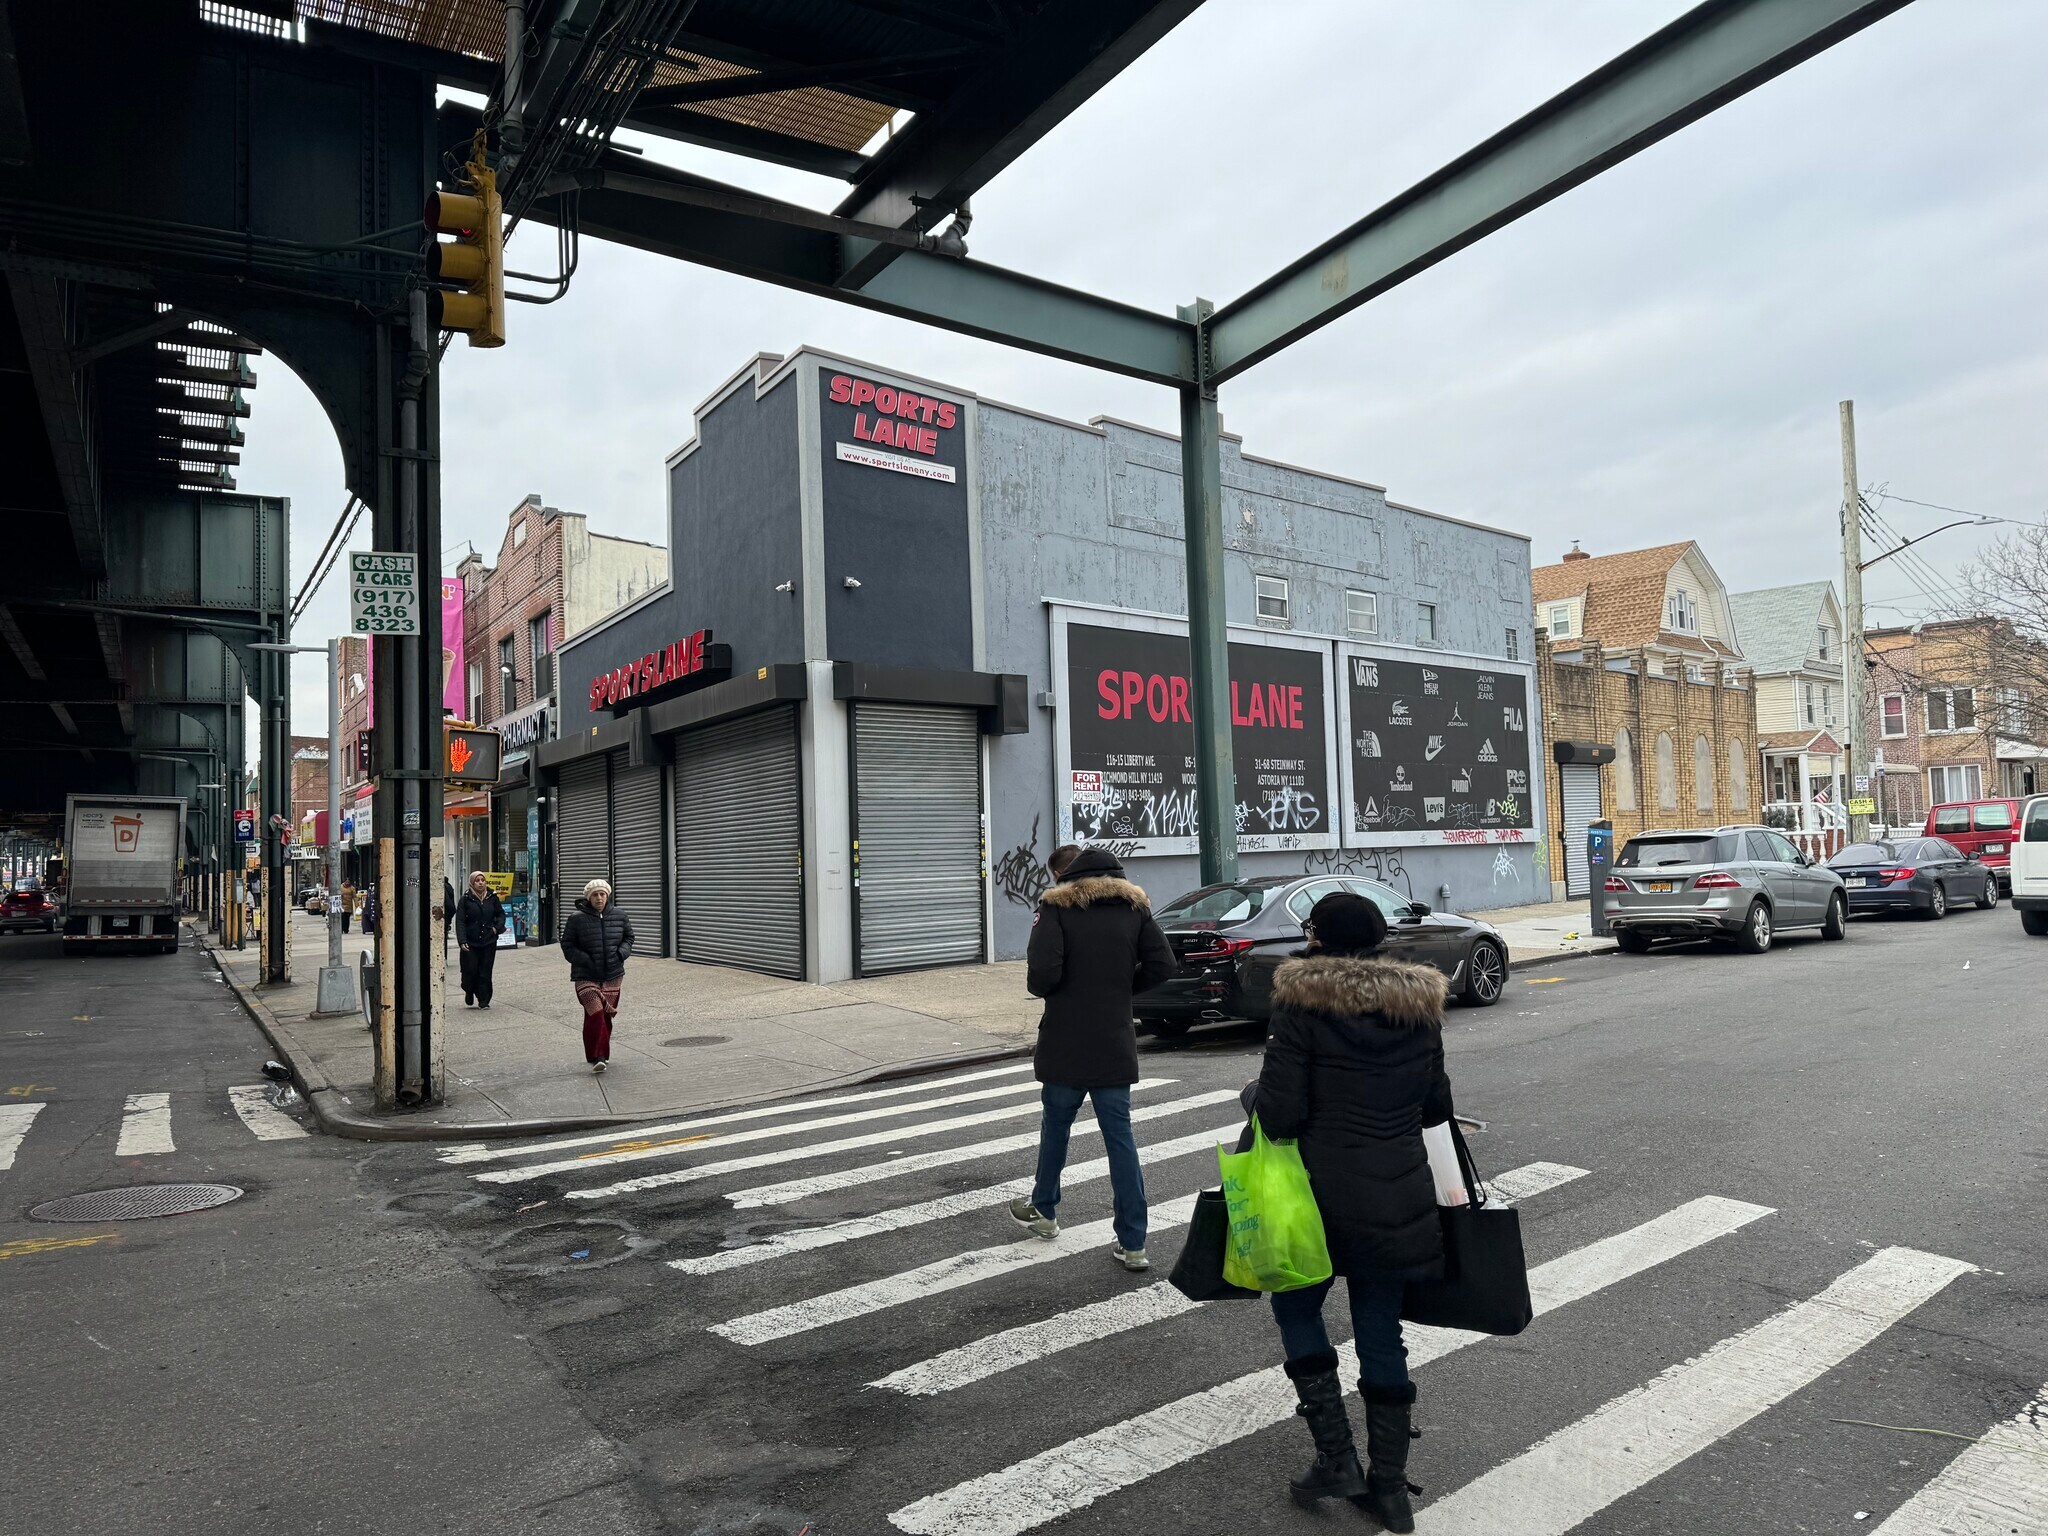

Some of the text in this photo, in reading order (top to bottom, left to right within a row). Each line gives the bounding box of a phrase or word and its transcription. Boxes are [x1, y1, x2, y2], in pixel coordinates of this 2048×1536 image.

[829, 375, 956, 429] SPORTS
[853, 412, 938, 455] LANE
[843, 452, 950, 480] www.sportslaneny.com
[356, 572, 412, 586] 4 CARS
[353, 588, 415, 605] (917)
[362, 605, 408, 618] 436
[355, 618, 415, 632] 8323
[589, 629, 706, 712] SPORTSLANE
[1353, 658, 1379, 688] VANS
[1477, 683, 1493, 692] KLEIN
[1097, 669, 1304, 729] SPOR LANE
[1476, 691, 1494, 700] JEANS
[1388, 716, 1413, 726] LACOSTE
[1503, 706, 1524, 732] FILA
[503, 710, 540, 751] PHARMACY
[1362, 730, 1373, 740] THE
[1356, 739, 1373, 748] NORTH
[1428, 735, 1442, 749] NIKE
[1361, 748, 1373, 757] FACE
[1477, 754, 1498, 762] adidas
[1106, 754, 1124, 766] 116-15
[1124, 755, 1145, 766] LIBERTY
[1254, 758, 1270, 770] 31-68
[1271, 759, 1297, 770] STEINWAY
[1076, 773, 1096, 782] FOR
[1101, 771, 1163, 784] RICHMOND HILL NY 11419
[1257, 774, 1305, 786] ASTORIA NY 11103
[1073, 782, 1100, 791] RENT
[1451, 779, 1469, 793] PUMA
[119, 829, 134, 843] D
